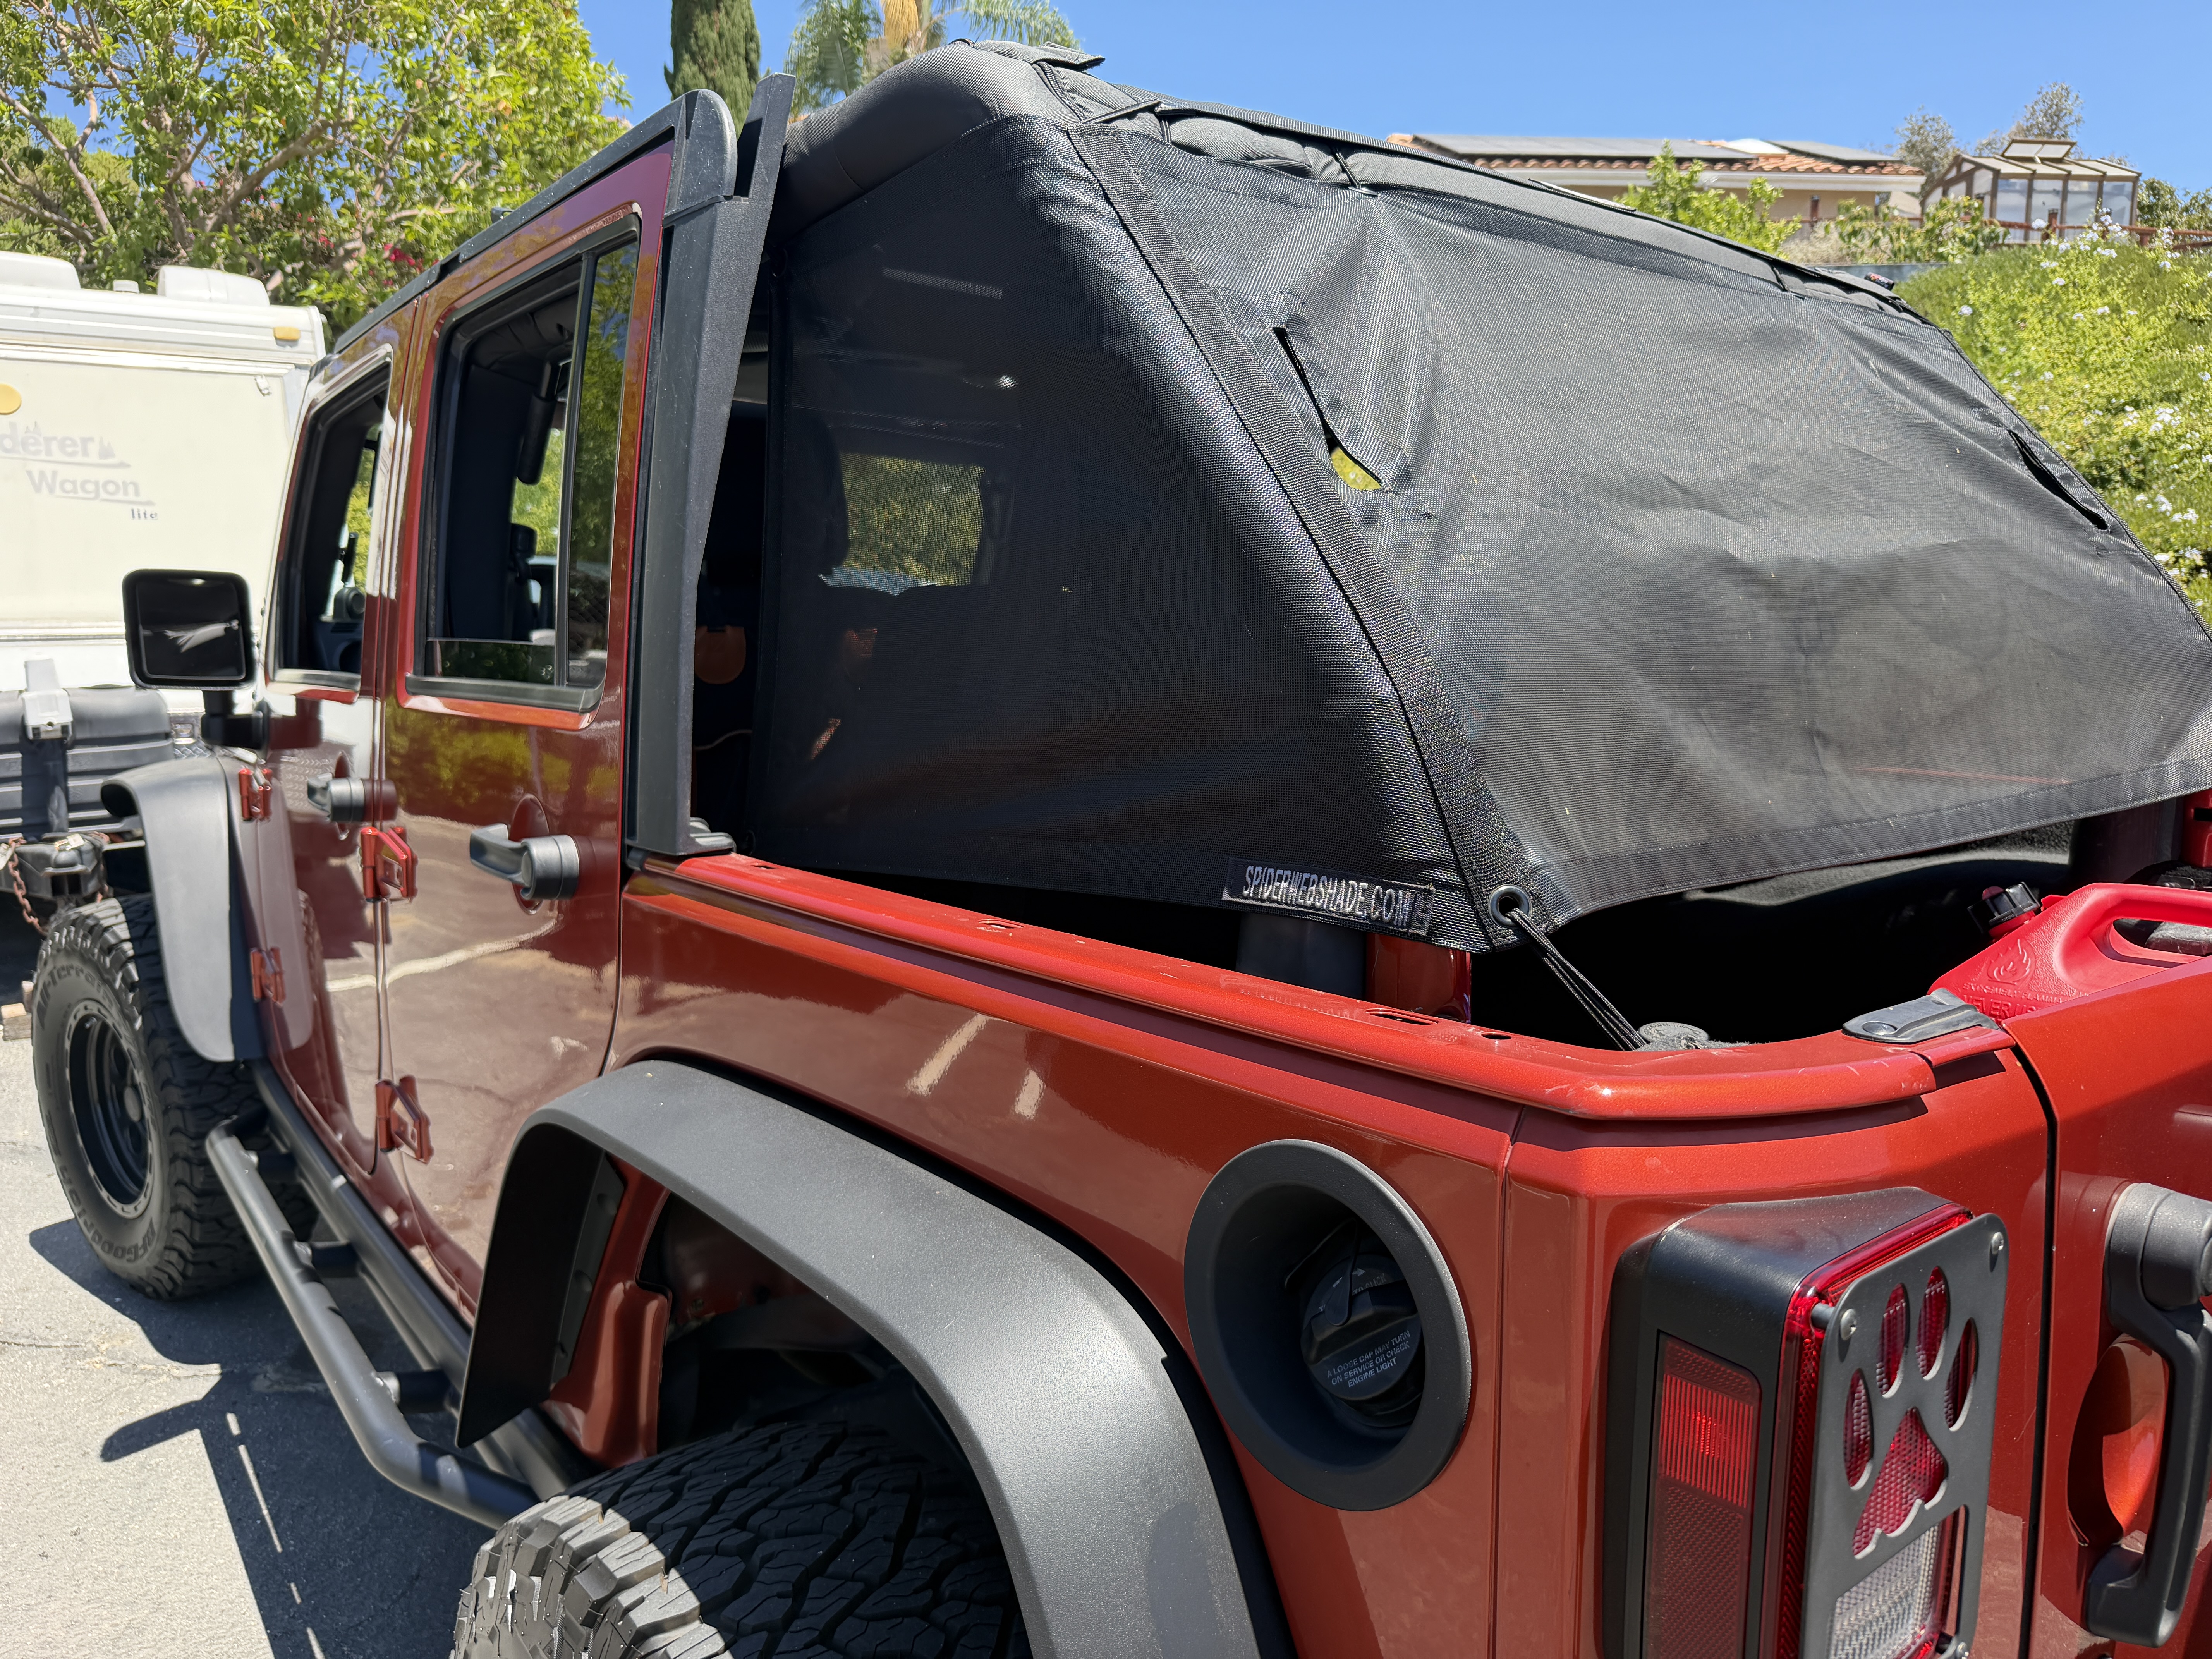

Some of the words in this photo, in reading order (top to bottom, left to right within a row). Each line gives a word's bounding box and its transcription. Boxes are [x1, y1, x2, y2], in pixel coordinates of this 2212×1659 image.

[26, 470, 141, 500] Wagon
[131, 508, 158, 520] lite
[1327, 1370, 1332, 1378] A
[1333, 1358, 1358, 1375] LOOSE
[1359, 1351, 1373, 1363] CAP
[1374, 1341, 1390, 1355] MAY
[1390, 1330, 1410, 1345] TURN
[1331, 1374, 1343, 1385] ON
[1344, 1360, 1374, 1379] SERVICE
[1375, 1354, 1386, 1363] OR
[1386, 1341, 1410, 1358] CHECK
[1348, 1368, 1375, 1387] ENGINE
[1376, 1357, 1396, 1373] LIGHT
